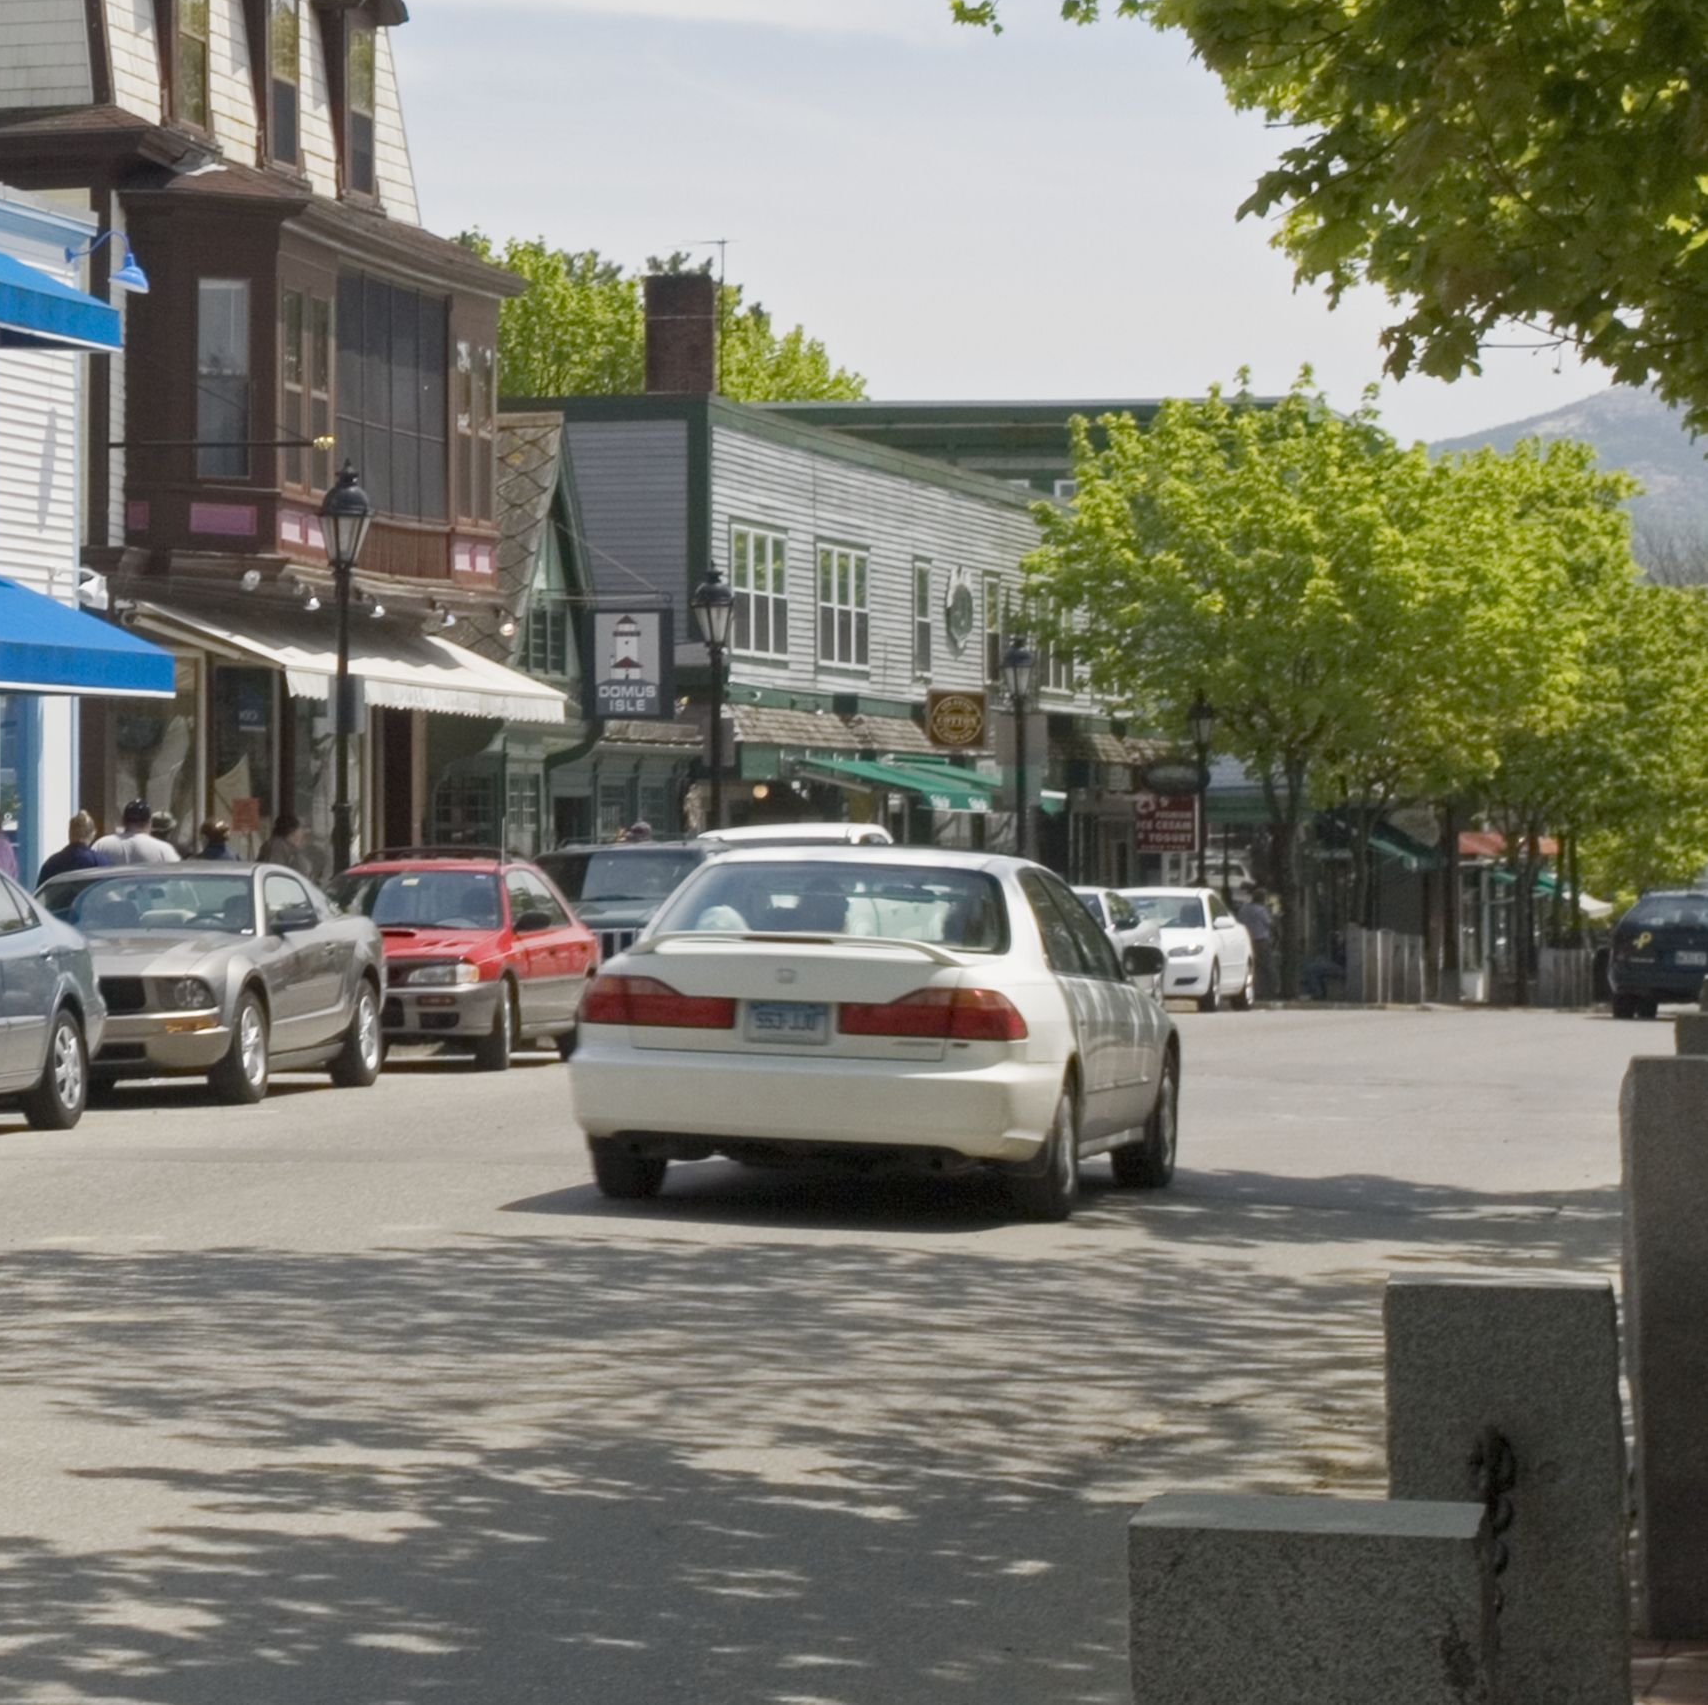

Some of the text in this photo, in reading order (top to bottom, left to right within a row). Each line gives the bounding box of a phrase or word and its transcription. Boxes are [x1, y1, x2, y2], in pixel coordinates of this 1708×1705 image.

[598, 685, 656, 698] DOMUS
[609, 699, 646, 711] ISLE
[1156, 820, 1192, 830] CREAM
